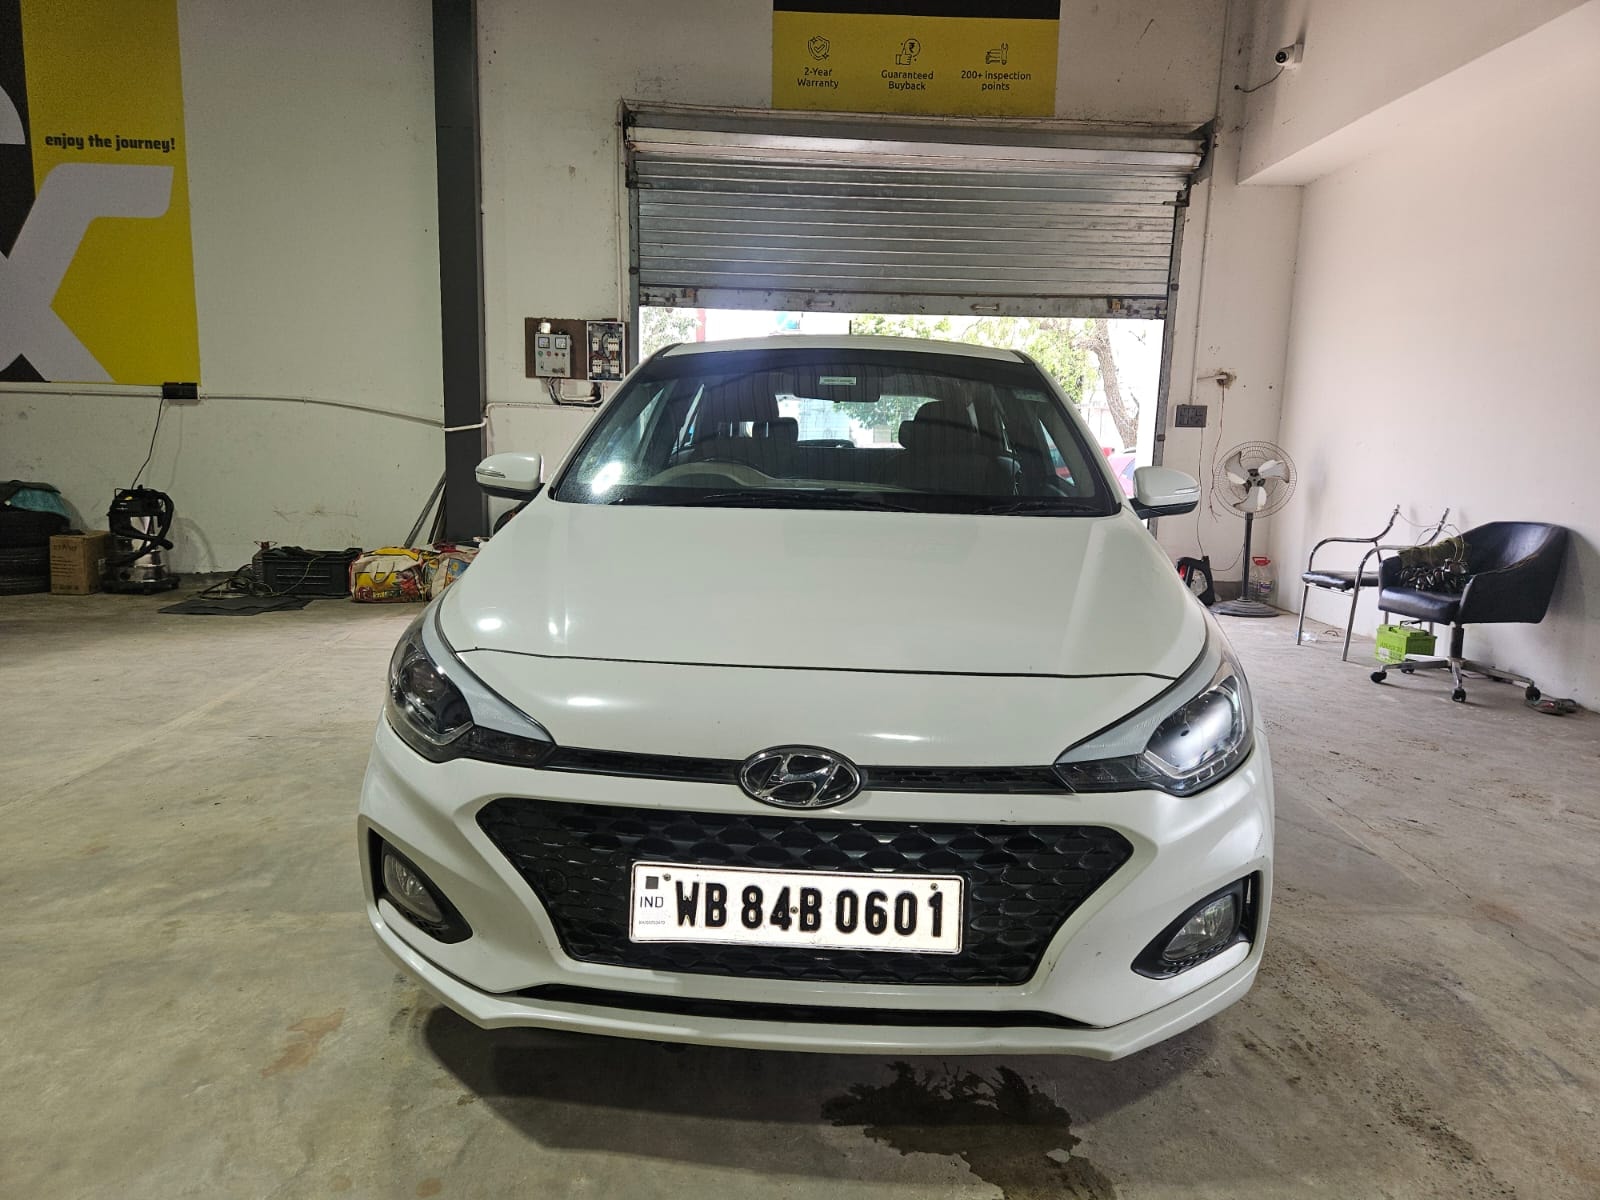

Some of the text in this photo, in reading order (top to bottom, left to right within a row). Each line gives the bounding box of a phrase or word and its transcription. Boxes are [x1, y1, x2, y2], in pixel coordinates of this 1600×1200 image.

[804, 67, 832, 77] 2-Year
[881, 69, 934, 80] Guaranteed
[961, 71, 1032, 82] 200+ inspection
[797, 78, 839, 90] Warranty
[888, 80, 926, 91] Buyback
[981, 82, 1010, 92] points
[45, 133, 176, 153] enjoy the journey!
[639, 895, 664, 908] IND
[676, 880, 727, 928] WB
[835, 889, 943, 937] 0601
